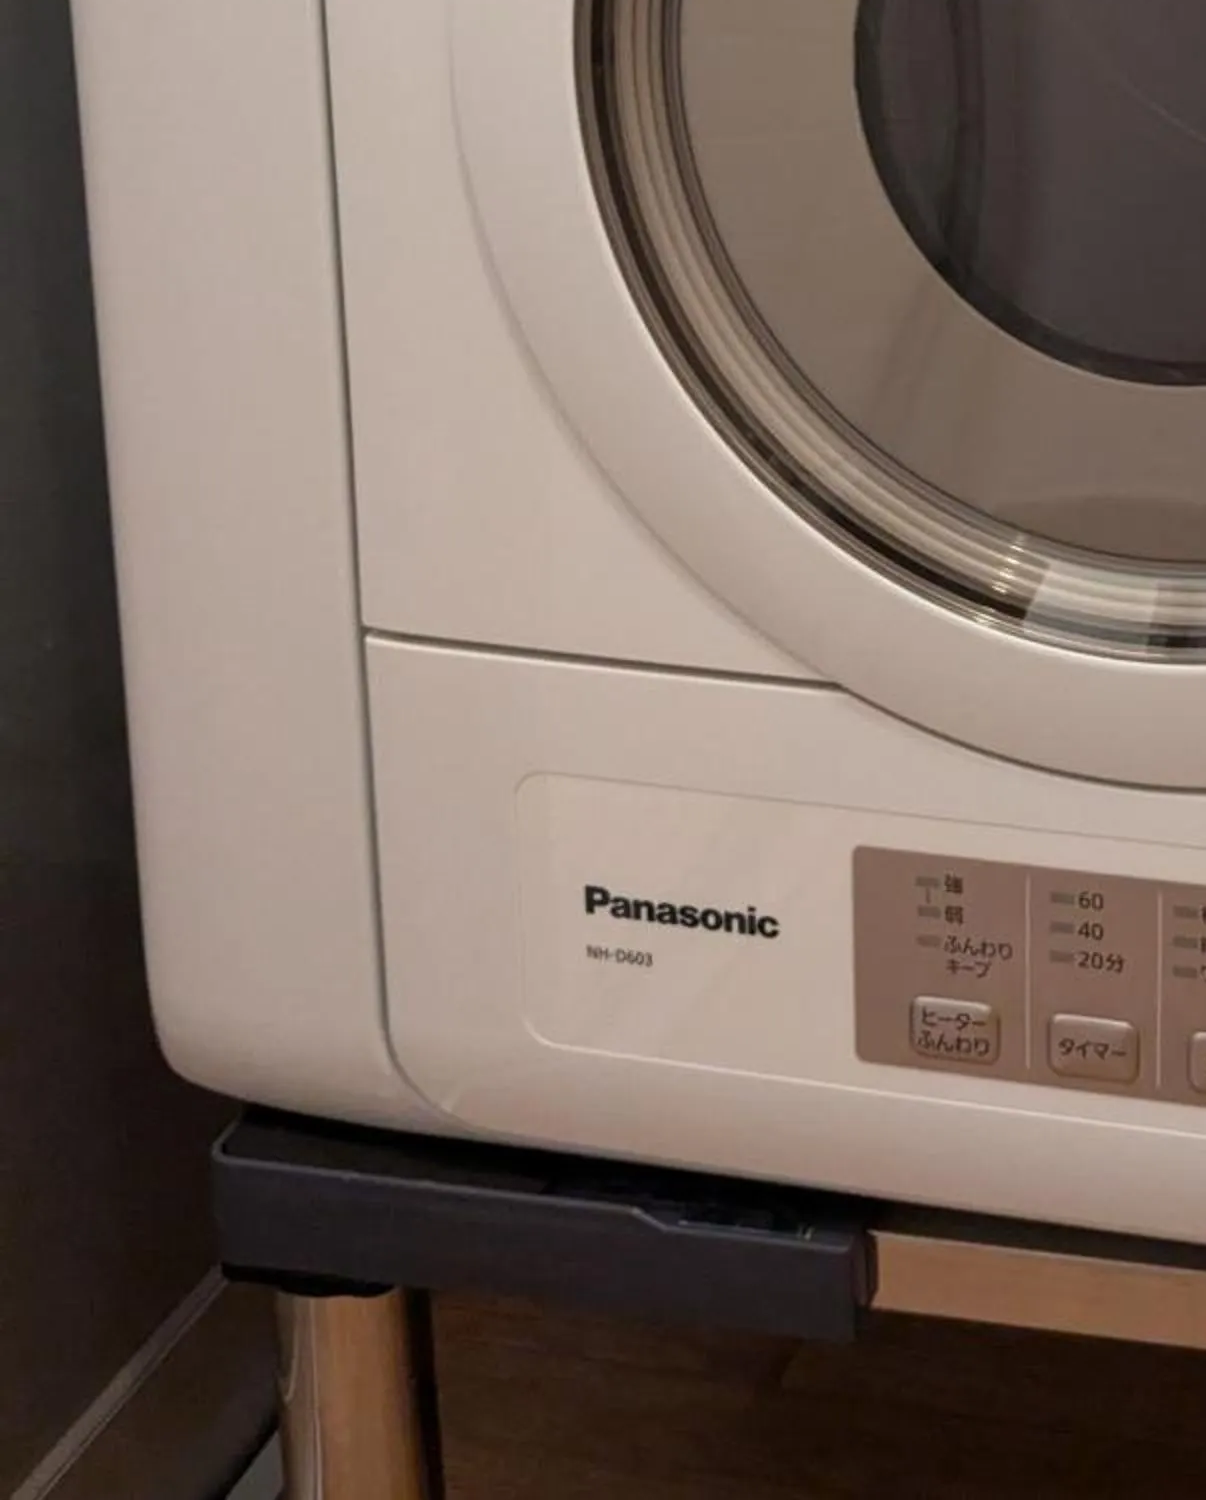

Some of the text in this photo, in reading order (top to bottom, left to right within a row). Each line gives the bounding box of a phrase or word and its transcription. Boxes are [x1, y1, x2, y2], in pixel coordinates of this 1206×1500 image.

[584, 884, 780, 940] Panasonic
[1078, 893, 1105, 911] 60
[1077, 922, 1105, 941] 40
[586, 945, 654, 967] NH-D603
[943, 935, 1014, 960] ふんわり
[1077, 951, 1126, 974] 20分
[920, 1009, 987, 1030] ヒーター
[917, 1030, 990, 1057] ふんわり
[1057, 1036, 1128, 1061] タイマー
